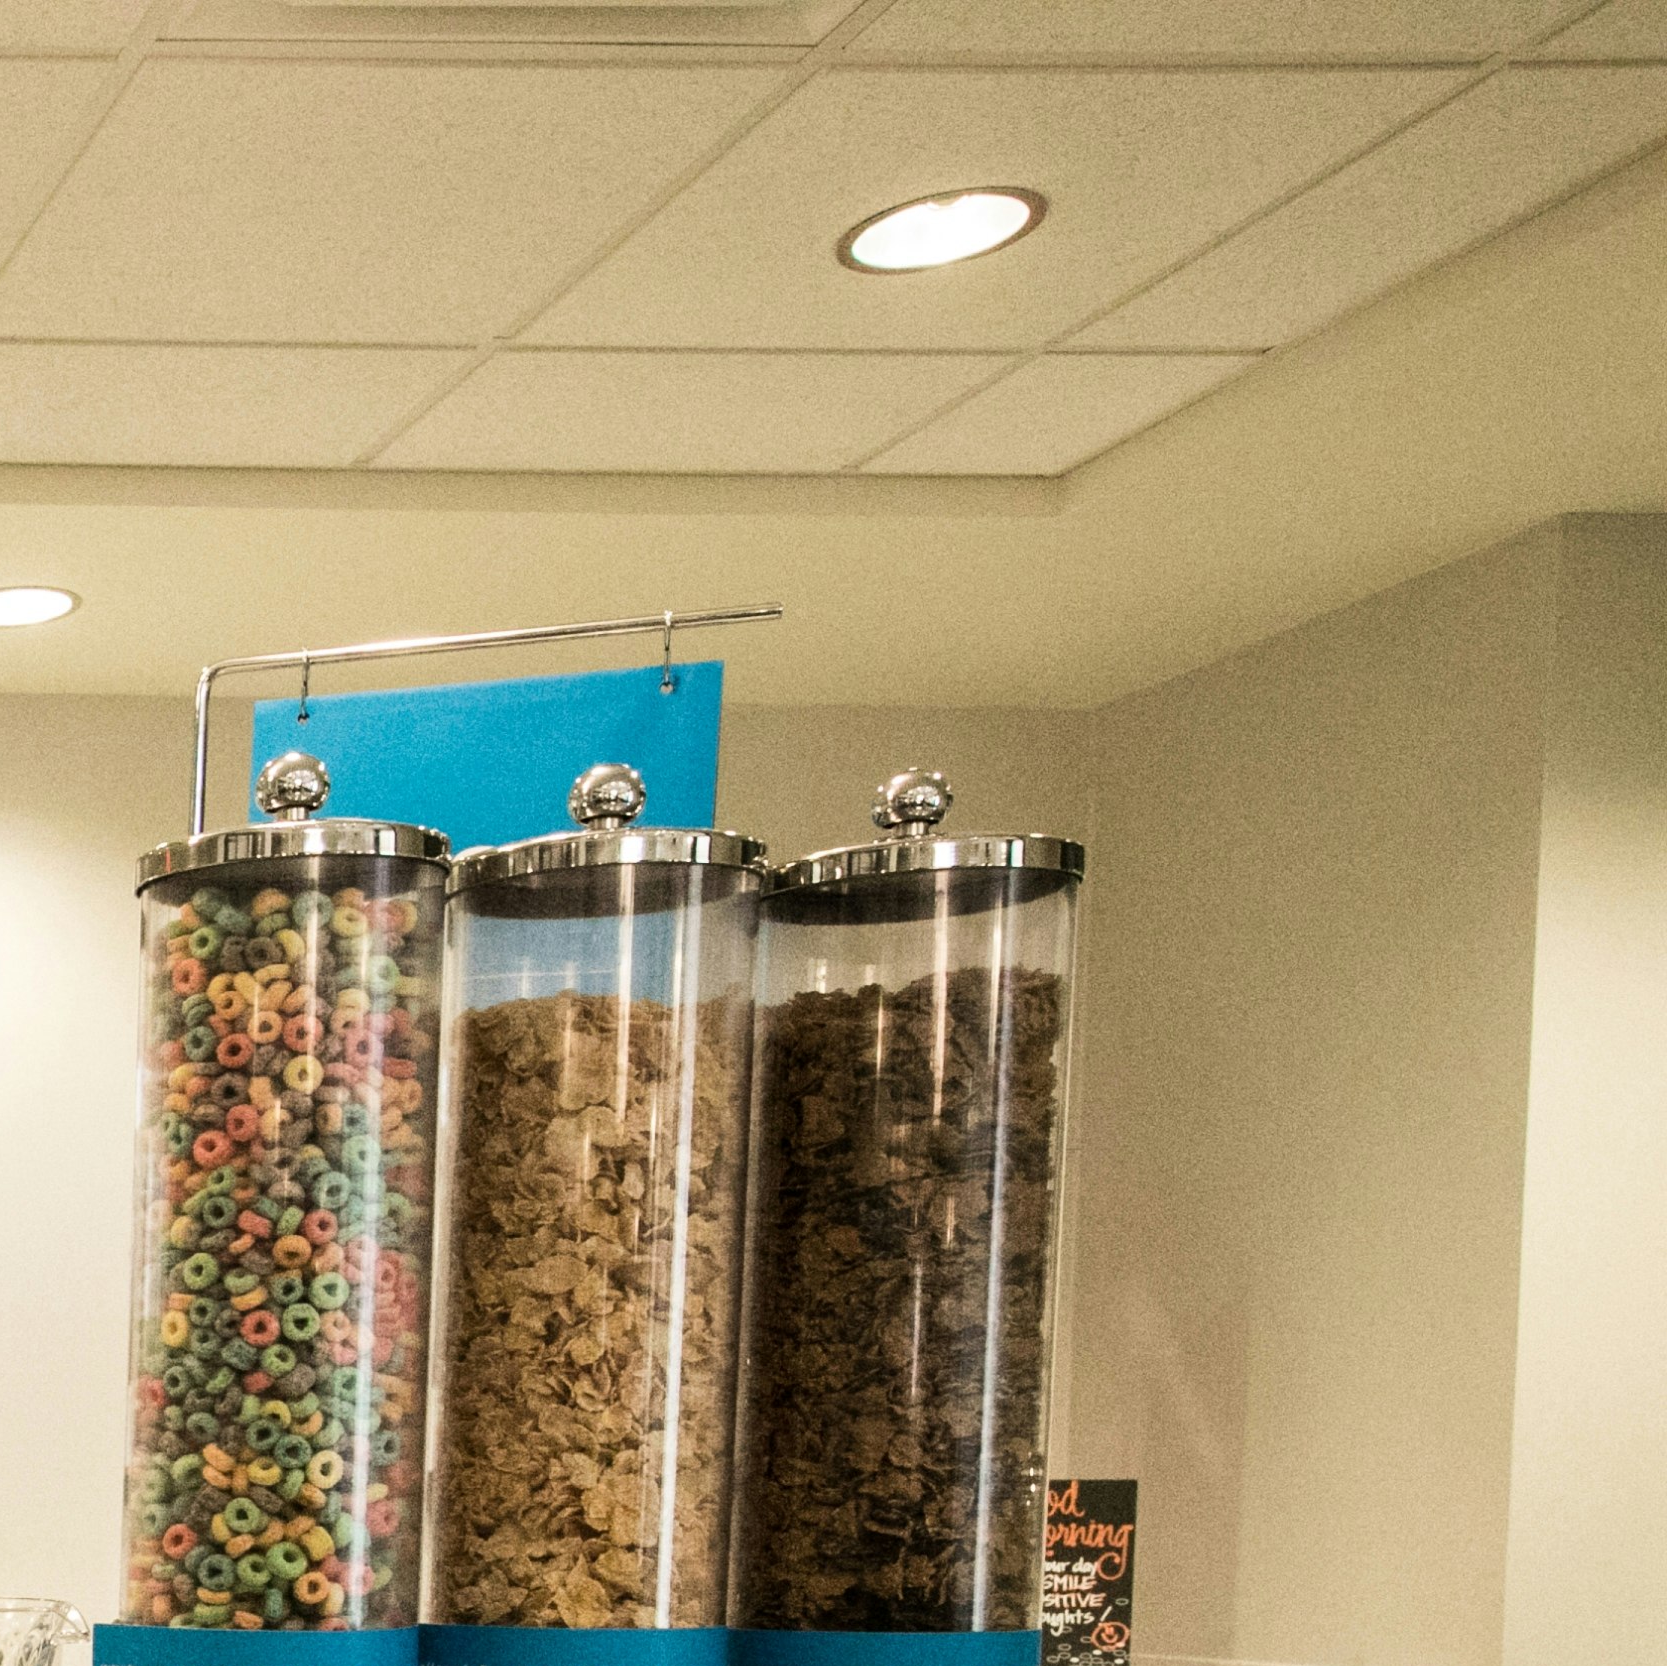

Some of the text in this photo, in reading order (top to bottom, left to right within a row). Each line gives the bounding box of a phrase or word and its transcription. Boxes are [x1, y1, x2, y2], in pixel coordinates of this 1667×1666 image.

[1047, 1478, 1086, 1517] od
[1046, 1519, 1134, 1580] orning
[1045, 1560, 1071, 1573] our
[1043, 1574, 1098, 1592] SMILE
[1044, 1592, 1106, 1609] SITIVE
